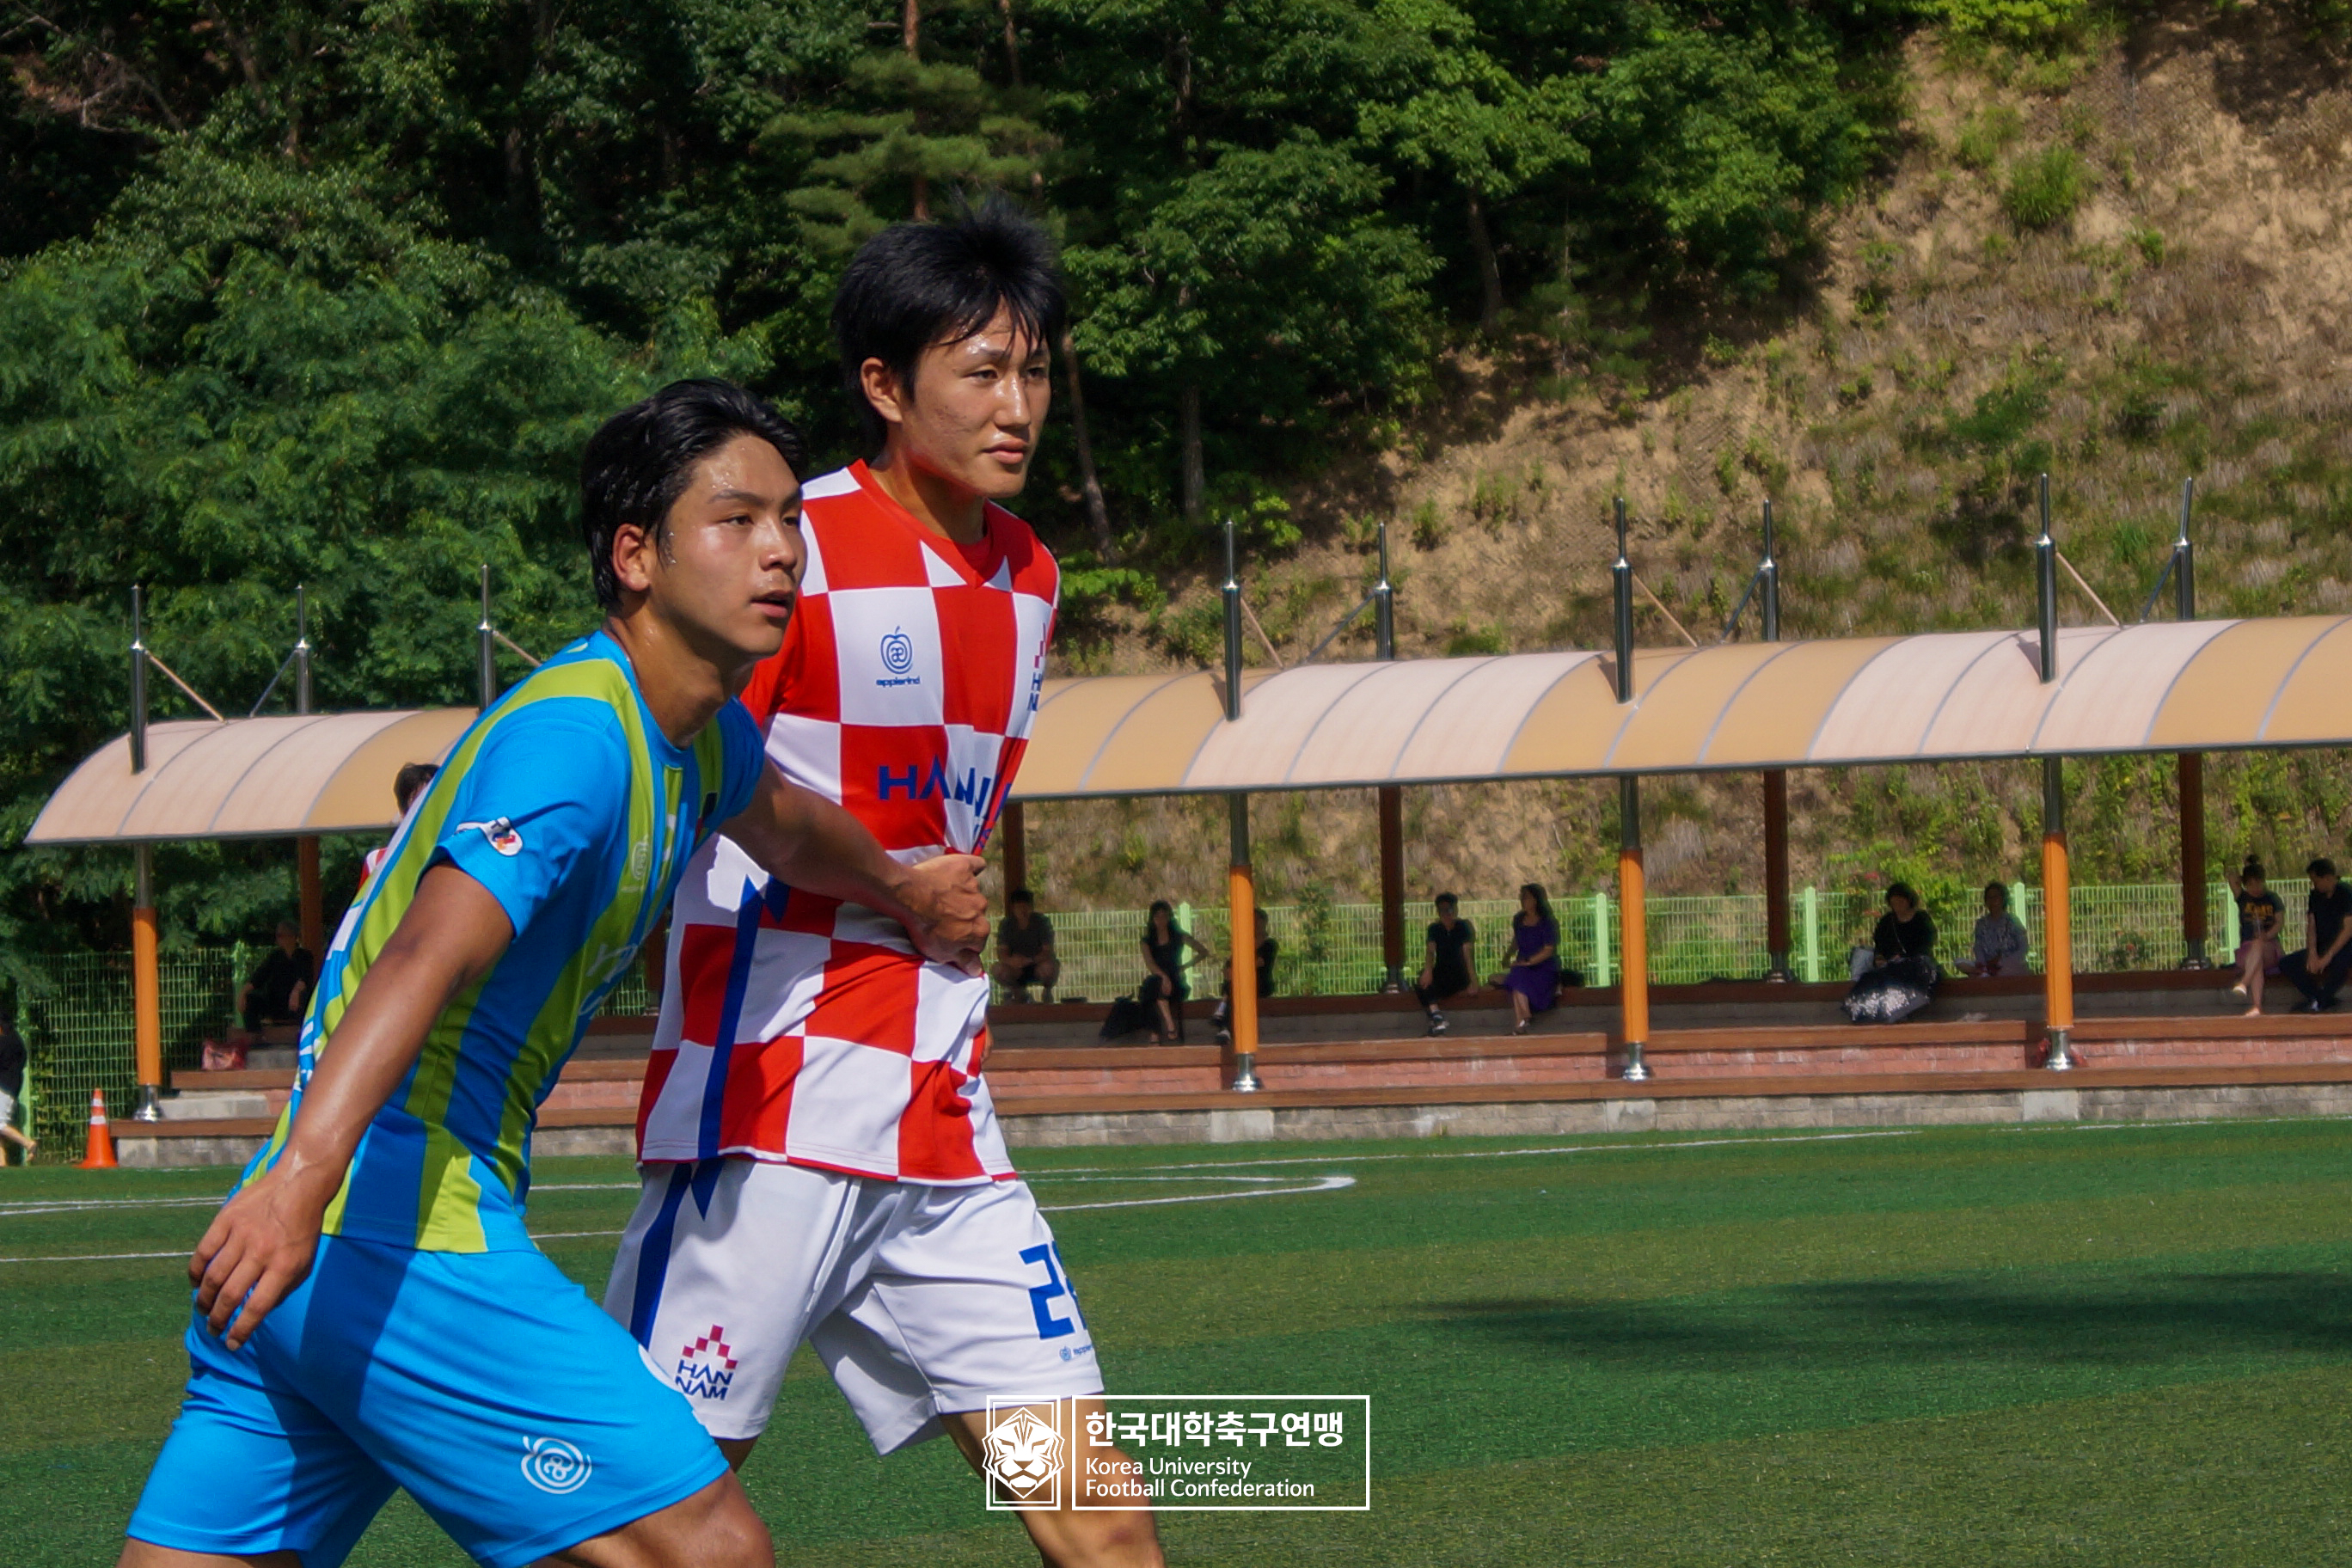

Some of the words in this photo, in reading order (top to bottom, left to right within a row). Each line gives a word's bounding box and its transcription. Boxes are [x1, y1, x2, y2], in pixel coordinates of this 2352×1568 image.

[1019, 1240, 1087, 1340] 2
[677, 1359, 734, 1386] HAN
[675, 1375, 729, 1401] NAM
